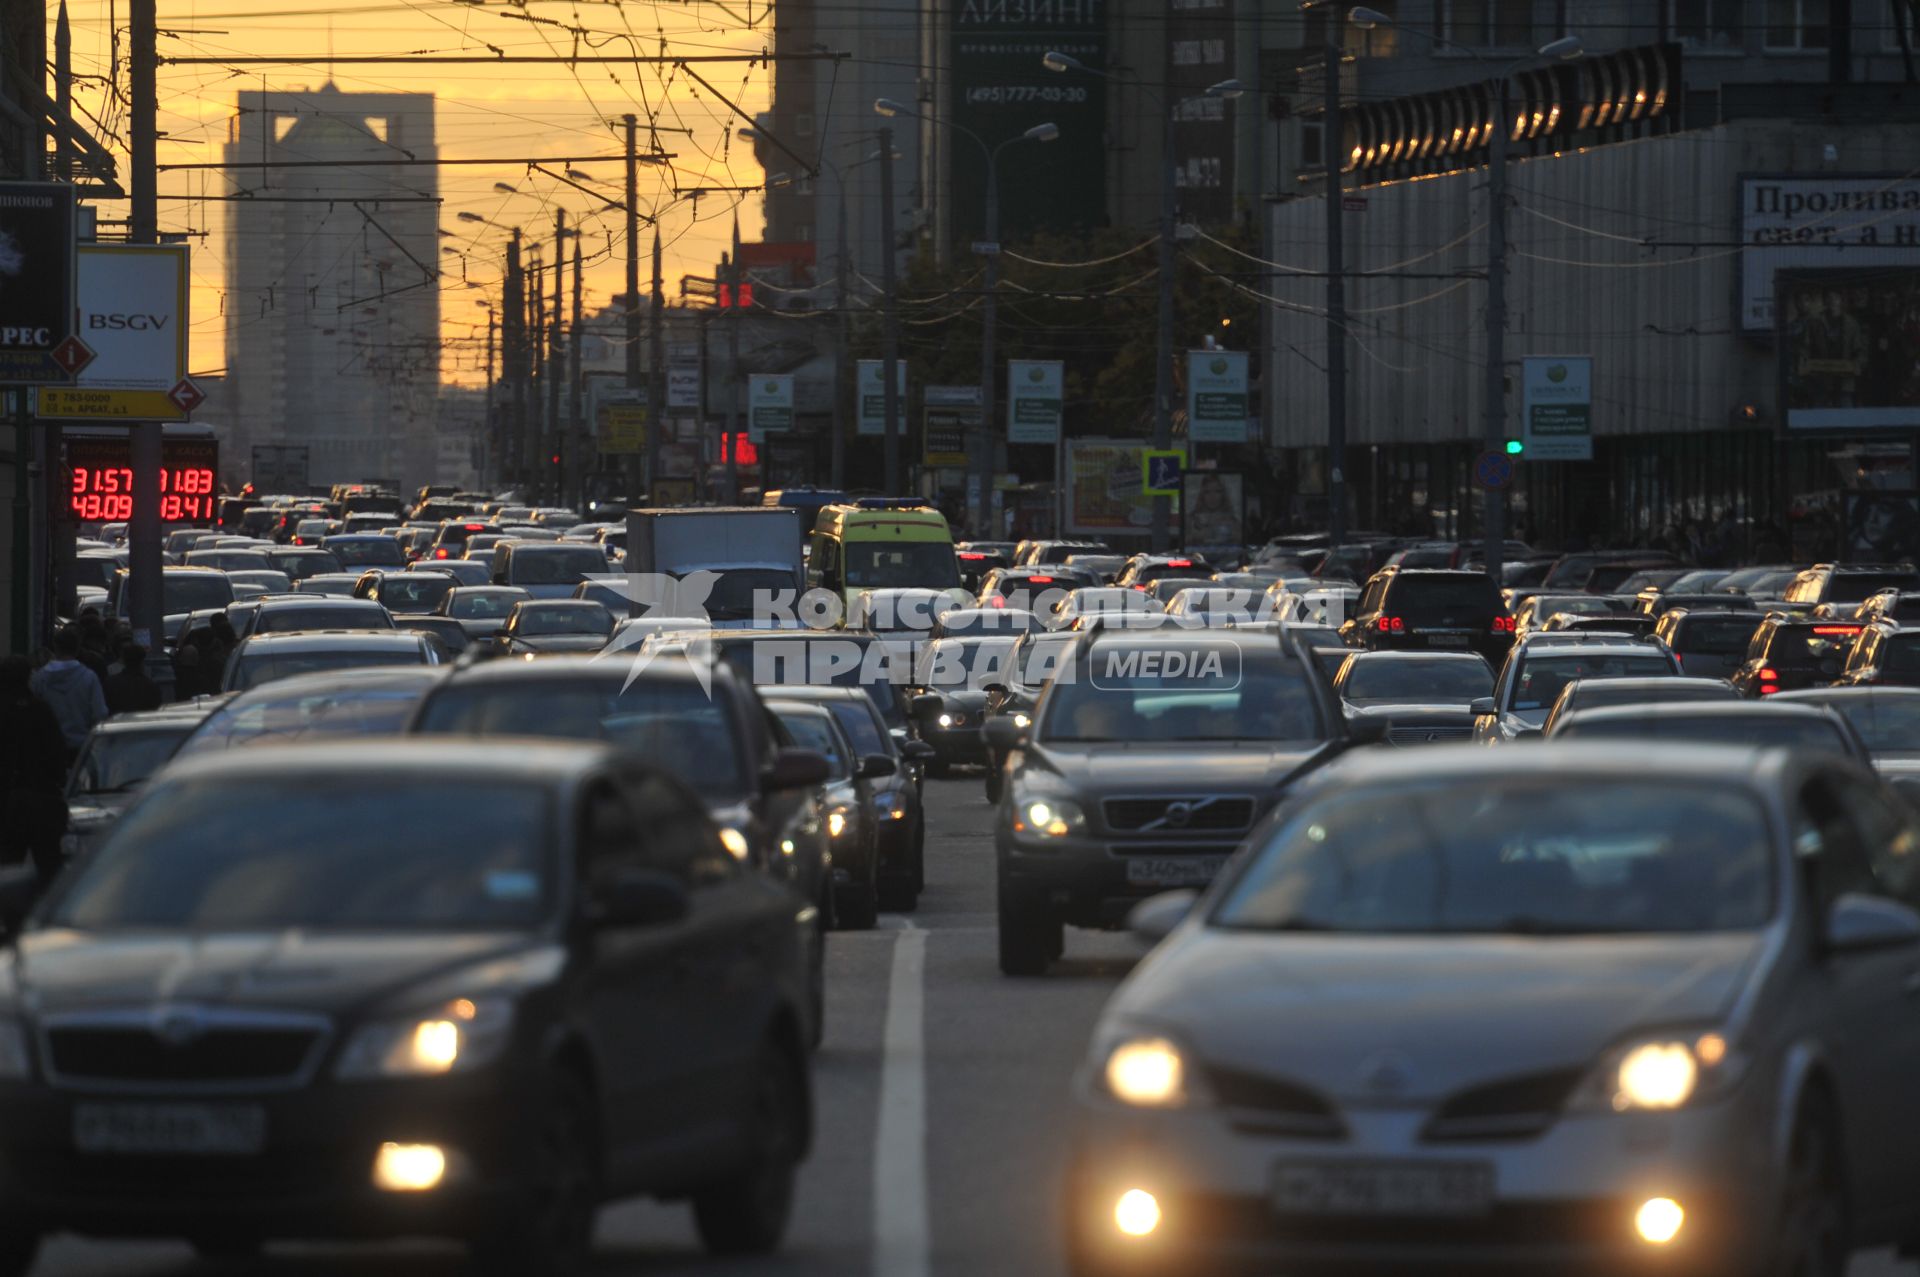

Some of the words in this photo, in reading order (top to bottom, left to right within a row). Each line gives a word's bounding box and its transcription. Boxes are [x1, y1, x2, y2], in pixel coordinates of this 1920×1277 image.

[89, 313, 168, 330] BSGV
[73, 468, 133, 492] 31.57
[73, 495, 133, 519] 43.09
